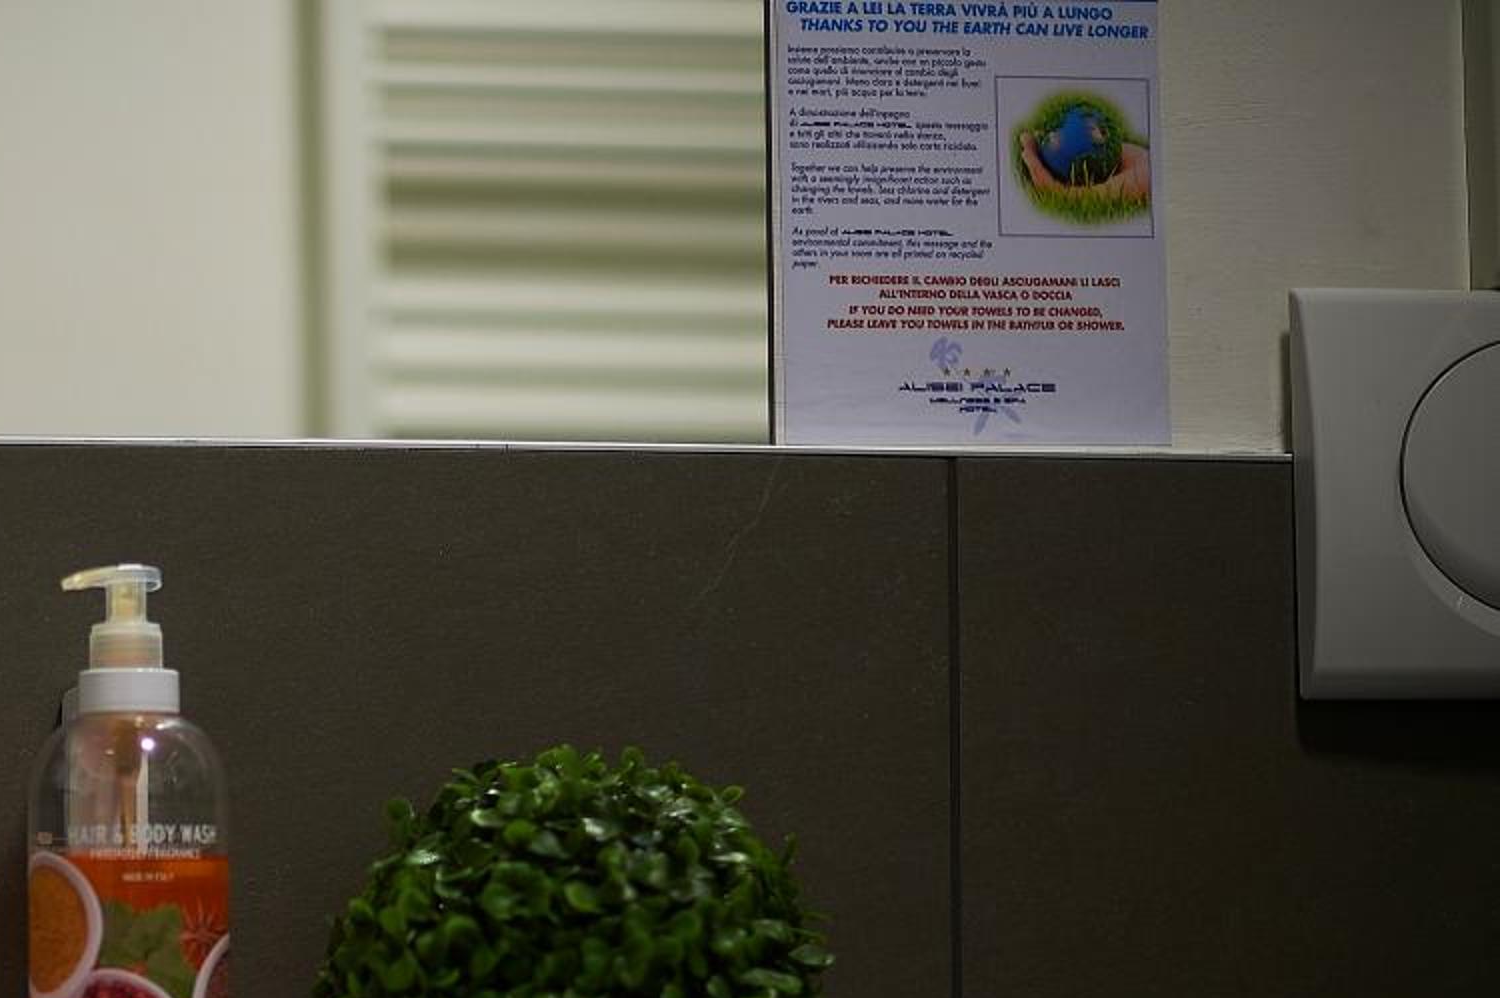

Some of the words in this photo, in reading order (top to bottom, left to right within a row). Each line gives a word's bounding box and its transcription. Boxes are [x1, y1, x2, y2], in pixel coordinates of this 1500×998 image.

[786, 1, 842, 14] GRAZIE
[847, 1, 858, 15] A
[864, 2, 883, 15] LEI
[888, 2, 908, 15] LA
[910, 3, 957, 17] TERRA
[1042, 5, 1054, 19] A
[1058, 7, 1113, 20] LUNGO
[801, 19, 863, 33] THANKS
[868, 20, 889, 33] TO
[894, 20, 927, 33] YOU
[932, 21, 959, 34] THE
[964, 22, 1011, 35] EARTH
[1016, 23, 1049, 36] CAN
[1053, 24, 1084, 37] LIVE
[1088, 25, 1150, 39] LONGER
[962, 48, 971, 57] la
[790, 106, 797, 117] A
[830, 275, 849, 285] PER
[924, 276, 967, 286] CAMBIO
[880, 289, 947, 300] ALL'INTERNO
[950, 290, 981, 300] DELLA
[984, 290, 1019, 301] VASCA
[1020, 290, 1030, 301] O
[1032, 290, 1073, 301] DOCCIA
[850, 305, 859, 315] IF
[862, 306, 885, 316] YOU
[888, 306, 905, 316] DO
[908, 306, 935, 316] NEED
[938, 306, 969, 317] YOUR
[972, 307, 1013, 317] TOWELS
[1016, 307, 1031, 317] TO
[1033, 308, 1046, 318] BE
[827, 319, 865, 329] PLEASE
[867, 320, 897, 330] LEAVE
[927, 320, 969, 331] TOWELS
[972, 320, 985, 330] IN
[987, 320, 1007, 331] THE
[1010, 320, 1055, 331] BATHTUB
[1058, 321, 1074, 331] OR
[971, 382, 1056, 393] PALACE
[68, 823, 107, 845] HAIR
[112, 823, 123, 845] &
[130, 823, 176, 845] BODY
[180, 823, 217, 845] WASH
